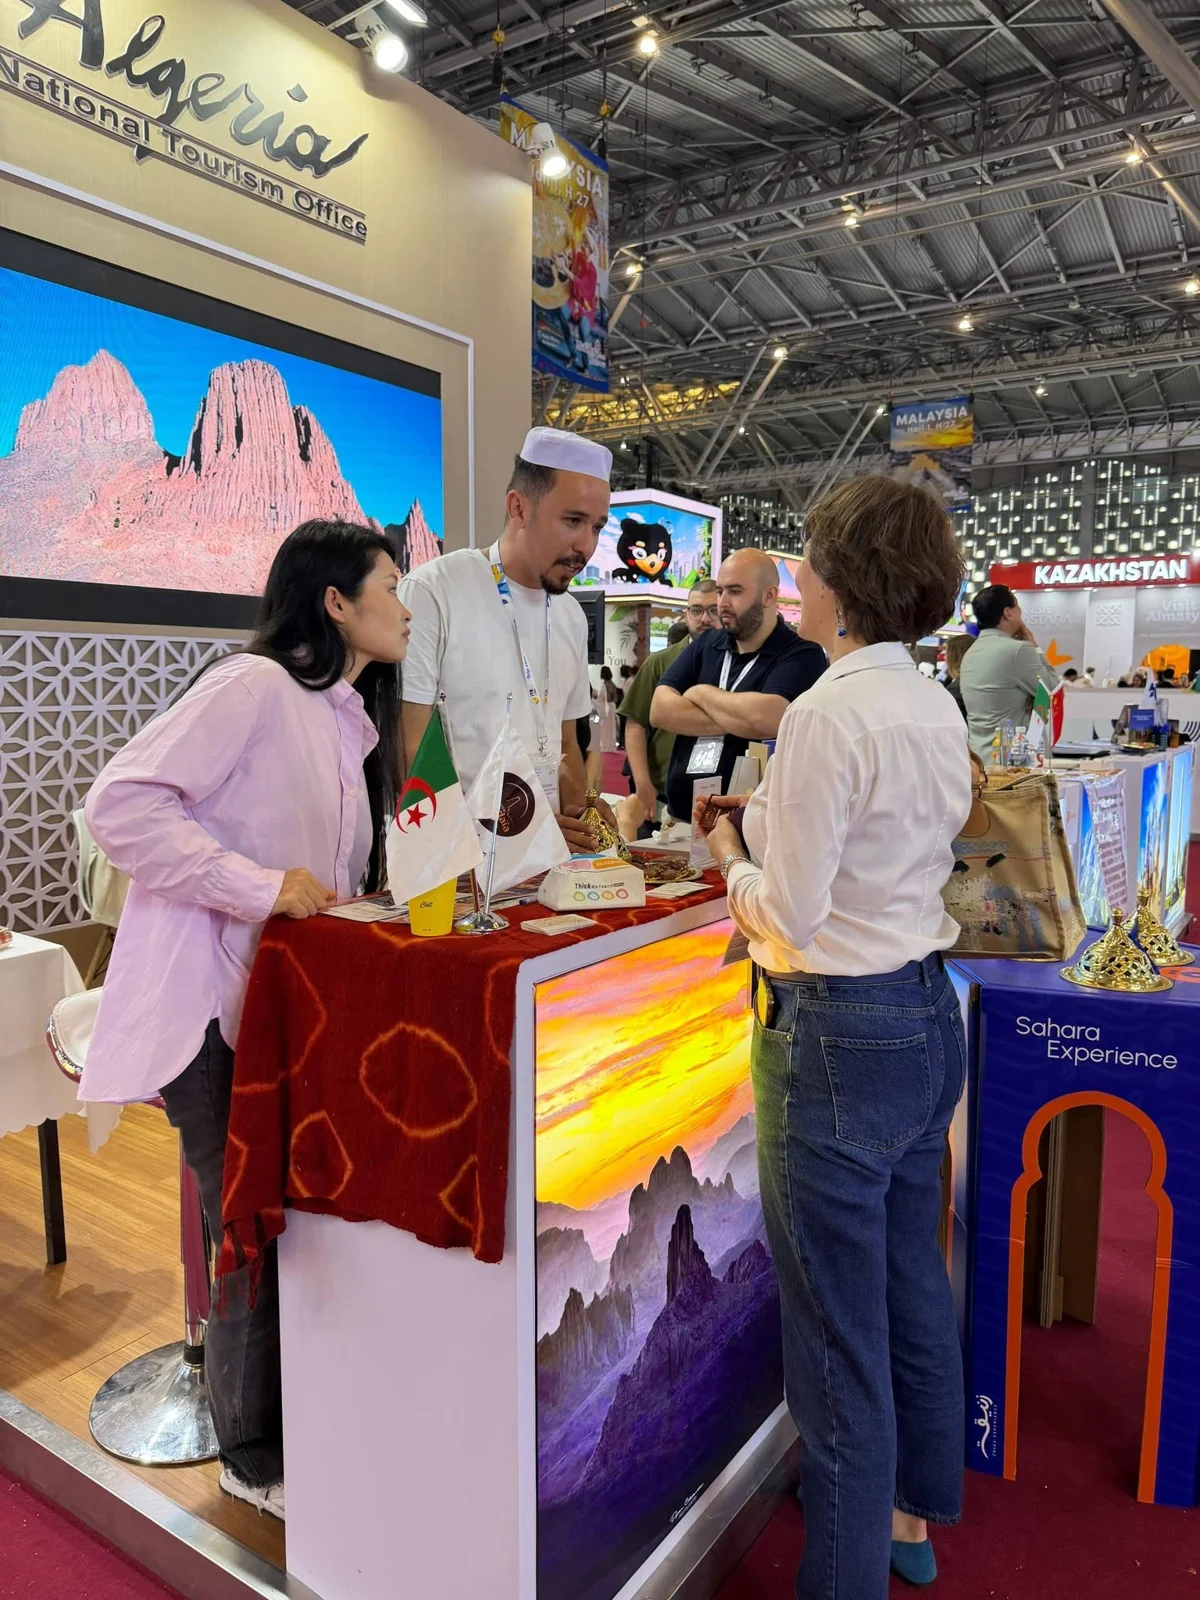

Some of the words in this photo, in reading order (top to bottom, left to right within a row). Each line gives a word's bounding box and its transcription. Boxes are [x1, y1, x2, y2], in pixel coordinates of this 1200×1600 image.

[18, 0, 369, 178] Algeria
[0, 54, 150, 143] National
[160, 127, 284, 201] Tourism
[294, 190, 368, 237] Office
[576, 191, 590, 209] 27
[896, 405, 968, 426] MALAYSIA
[1034, 559, 1188, 585] KAZAKHSTAN
[1016, 1016, 1100, 1041] Sahara
[1047, 1039, 1178, 1069] Experience
